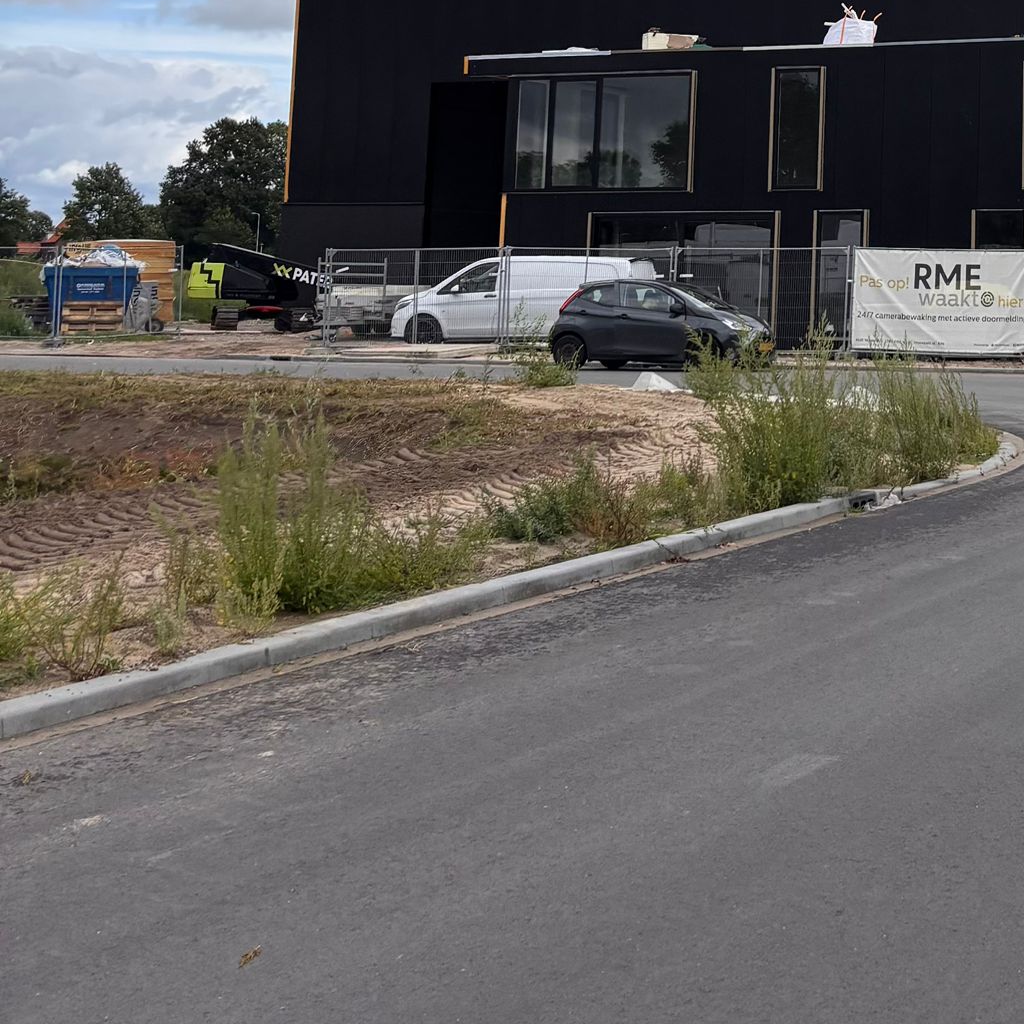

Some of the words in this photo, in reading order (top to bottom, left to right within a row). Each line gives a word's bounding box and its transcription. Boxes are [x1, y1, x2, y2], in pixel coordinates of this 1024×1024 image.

[859, 275, 883, 288] Pas
[887, 277, 909, 291] op!
[914, 263, 982, 290] RME
[918, 290, 978, 307] waakt
[857, 311, 874, 319] 24/7
[875, 312, 937, 323] camerabewaking
[937, 314, 953, 322] met
[953, 314, 981, 323] actieve
